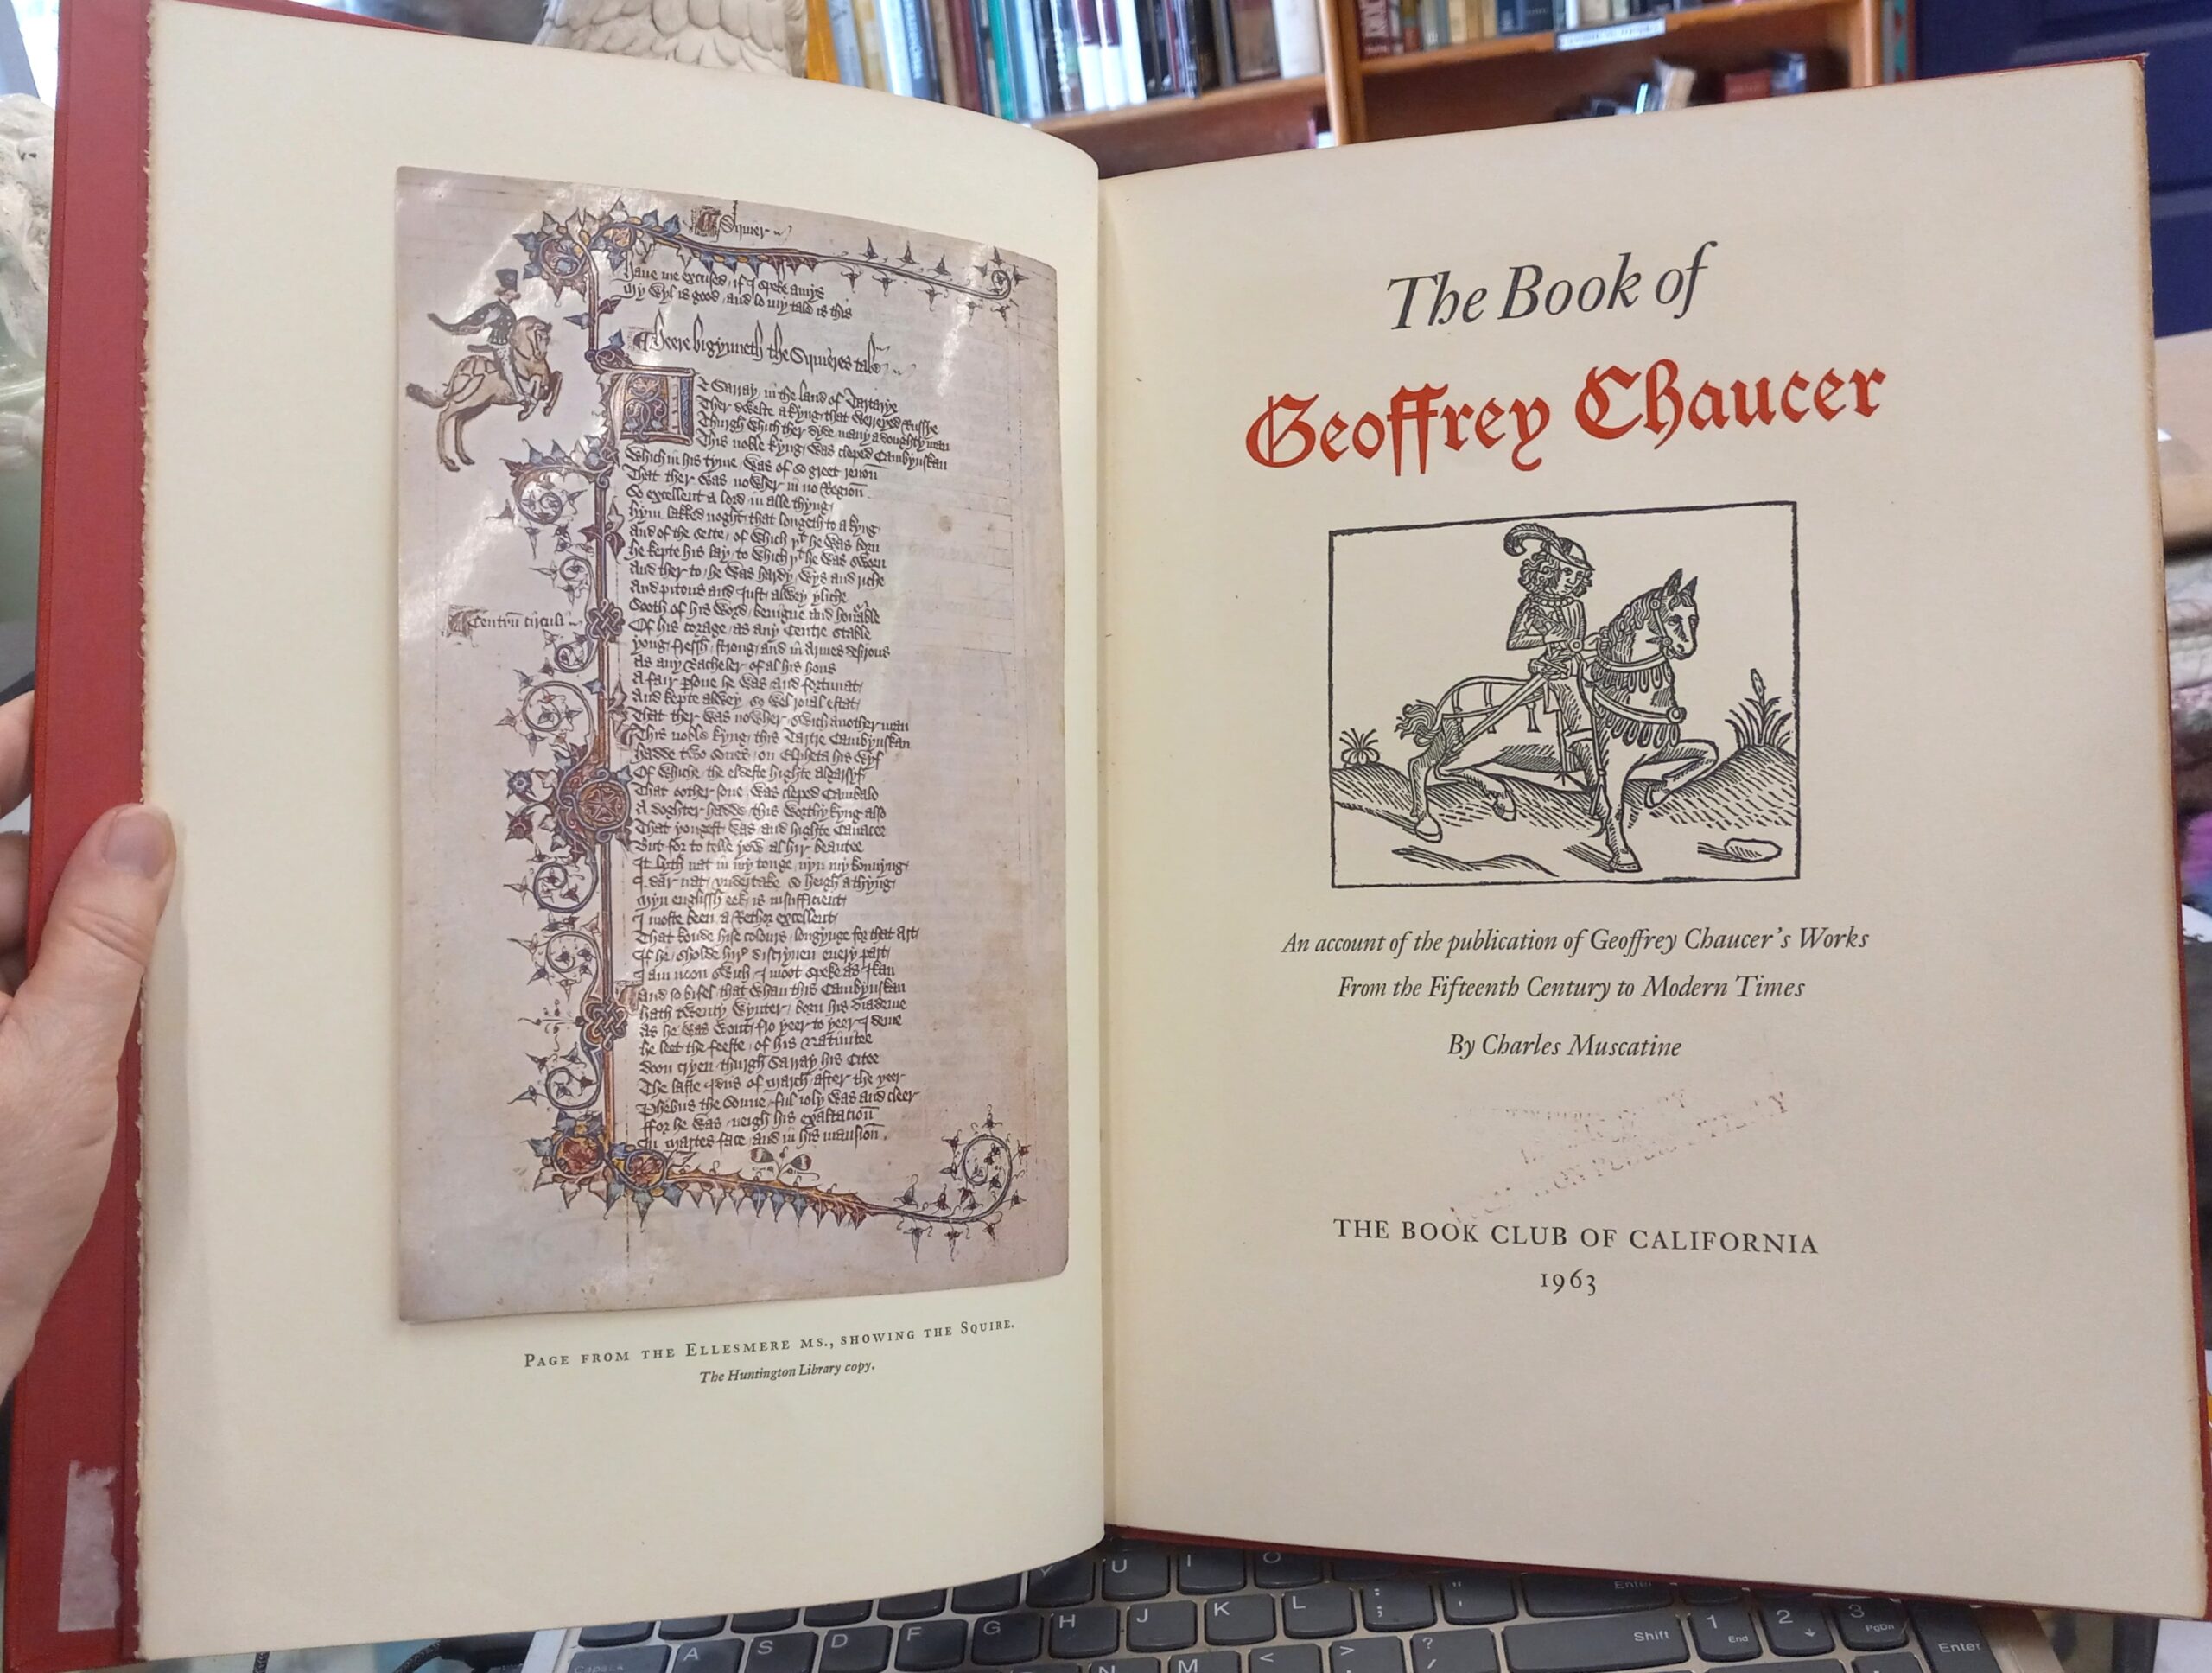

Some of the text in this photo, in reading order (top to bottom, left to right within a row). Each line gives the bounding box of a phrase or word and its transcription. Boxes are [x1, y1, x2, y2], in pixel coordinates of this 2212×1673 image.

[1386, 240, 1719, 331] The Book of
[1244, 358, 1887, 477] Geoffrey Chaucer
[1280, 925, 1870, 960] An account of the publication of Geoffrey Chaucer's Works
[1336, 974, 1806, 1006] From the Fifteenth Century to Modern Times
[1446, 1032, 1682, 1060] By Charles Muscatine
[1332, 1217, 1819, 1255] THE BOOK CLUB OF CALIFORNIA
[1541, 1268, 1596, 1297] 1963
[699, 1370, 725, 1384] The
[727, 1368, 797, 1382] Huntington
[1112, 1559, 1128, 1574] U
[1214, 1601, 1230, 1616] K
[1292, 1596, 1306, 1610] L
[1136, 1608, 1149, 1623] J
[1777, 1609, 1793, 1624] 2
[1849, 1604, 1866, 1618] 3
[983, 1621, 1001, 1636] G
[1059, 1614, 1076, 1629] H
[1706, 1614, 1718, 1629] 1
[1866, 1623, 1895, 1633] PgDn
[831, 1634, 849, 1648] D
[908, 1626, 922, 1642] F
[1633, 1630, 1670, 1643] Shift
[1728, 1634, 1749, 1643] End
[683, 1646, 699, 1662] A
[757, 1641, 773, 1655] S
[1938, 1641, 1982, 1654] Enter
[1178, 1659, 1198, 1673] M
